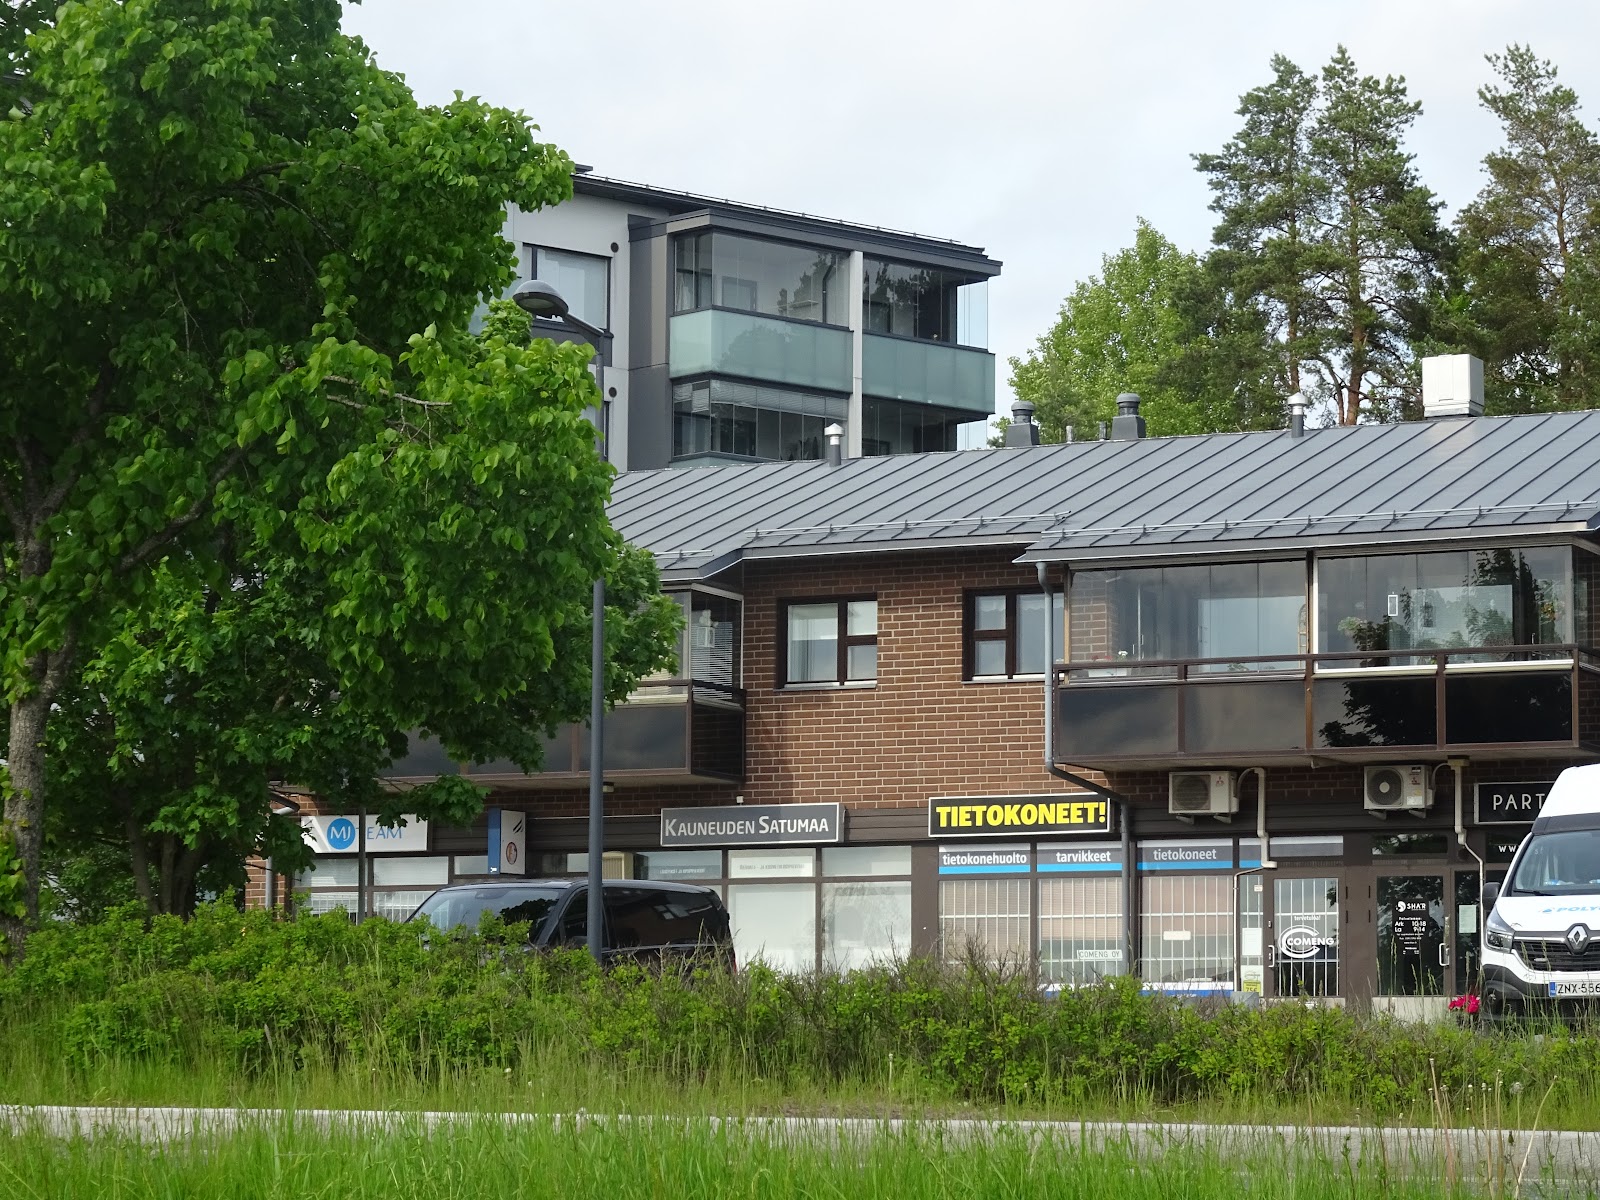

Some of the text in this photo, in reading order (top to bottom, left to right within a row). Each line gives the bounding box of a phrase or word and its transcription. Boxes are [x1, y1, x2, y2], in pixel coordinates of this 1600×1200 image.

[936, 801, 1106, 828] TIETOKONEET!
[664, 815, 829, 837] KAUNEUDEN SATUMAA
[330, 826, 351, 842] MJ
[942, 852, 1027, 866] tietokonehuolto
[1056, 850, 1111, 863] tarvikkeet
[1153, 848, 1217, 861] tietokoneet
[1287, 937, 1334, 945] COMENG
[1079, 950, 1120, 958] COMENG OY
